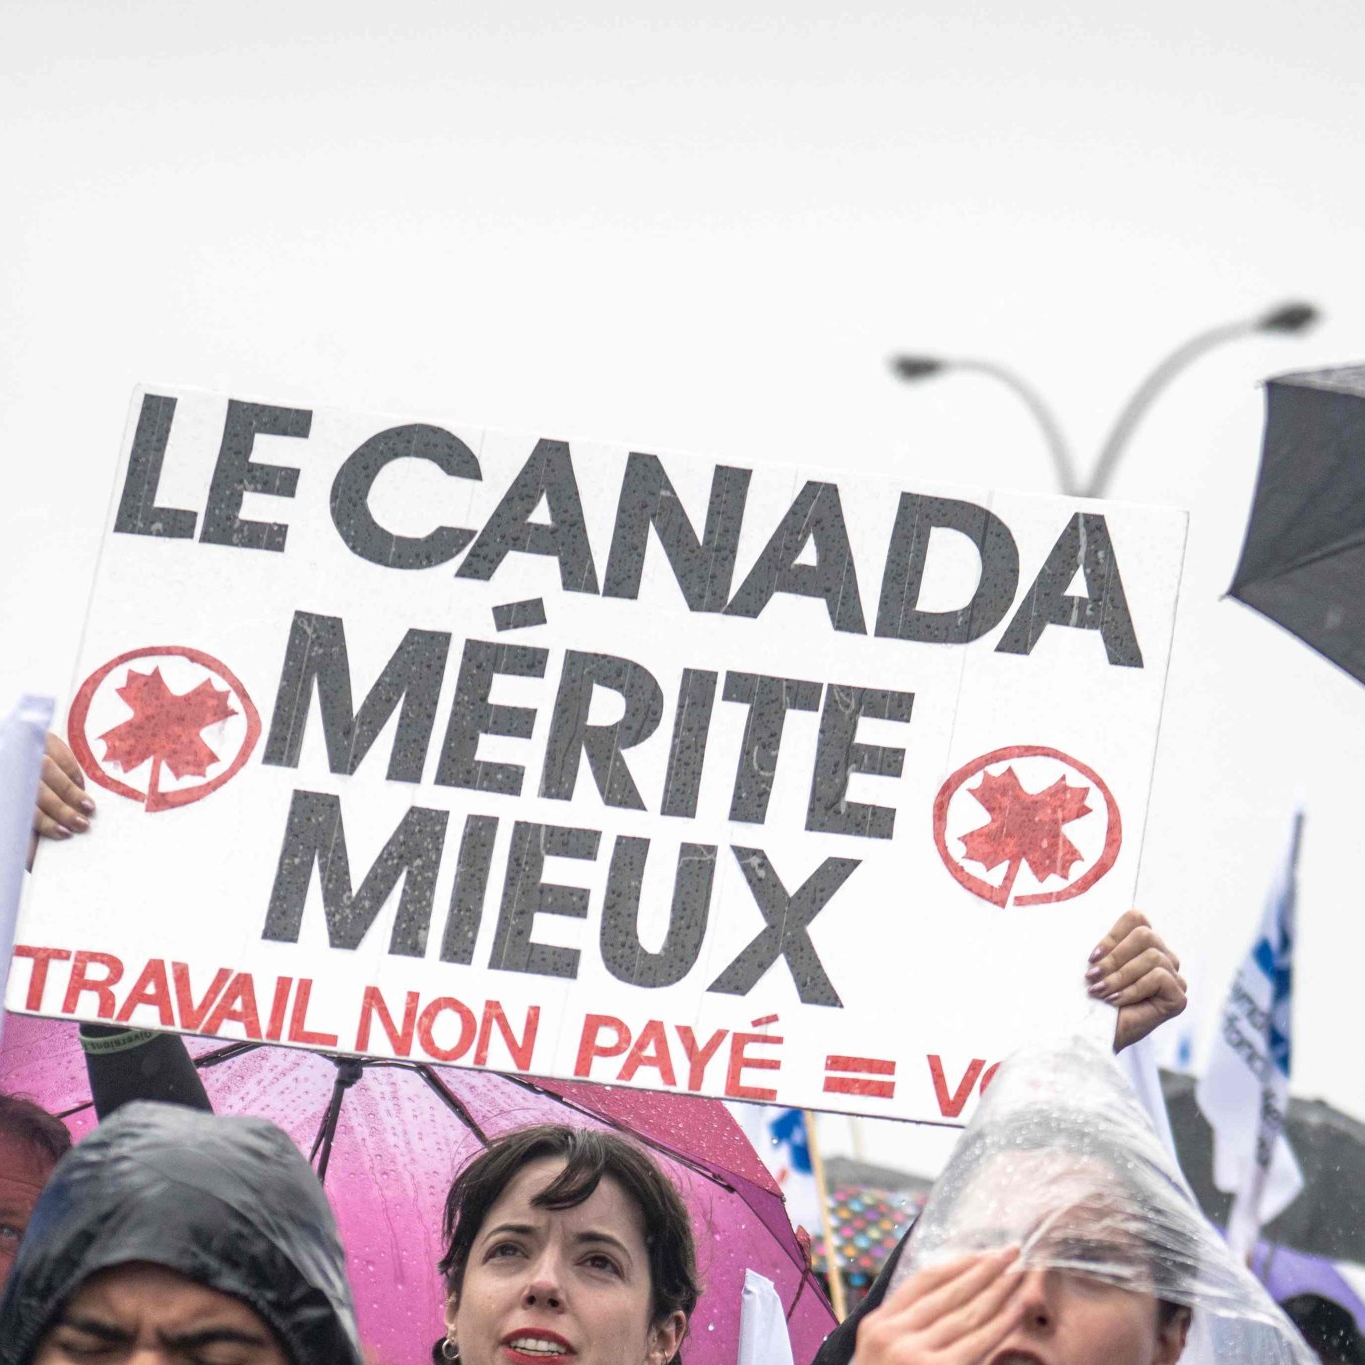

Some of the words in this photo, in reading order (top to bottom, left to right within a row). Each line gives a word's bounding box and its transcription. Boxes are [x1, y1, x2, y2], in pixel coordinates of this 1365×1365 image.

[113, 393, 313, 553] LE
[329, 423, 1144, 669] CANADA
[261, 597, 916, 840] MÉRITE
[261, 788, 863, 1009] MIEUX
[12, 944, 338, 1048] TRAVAIL
[355, 986, 540, 1071] NON
[573, 1013, 784, 1101] PAYÉ
